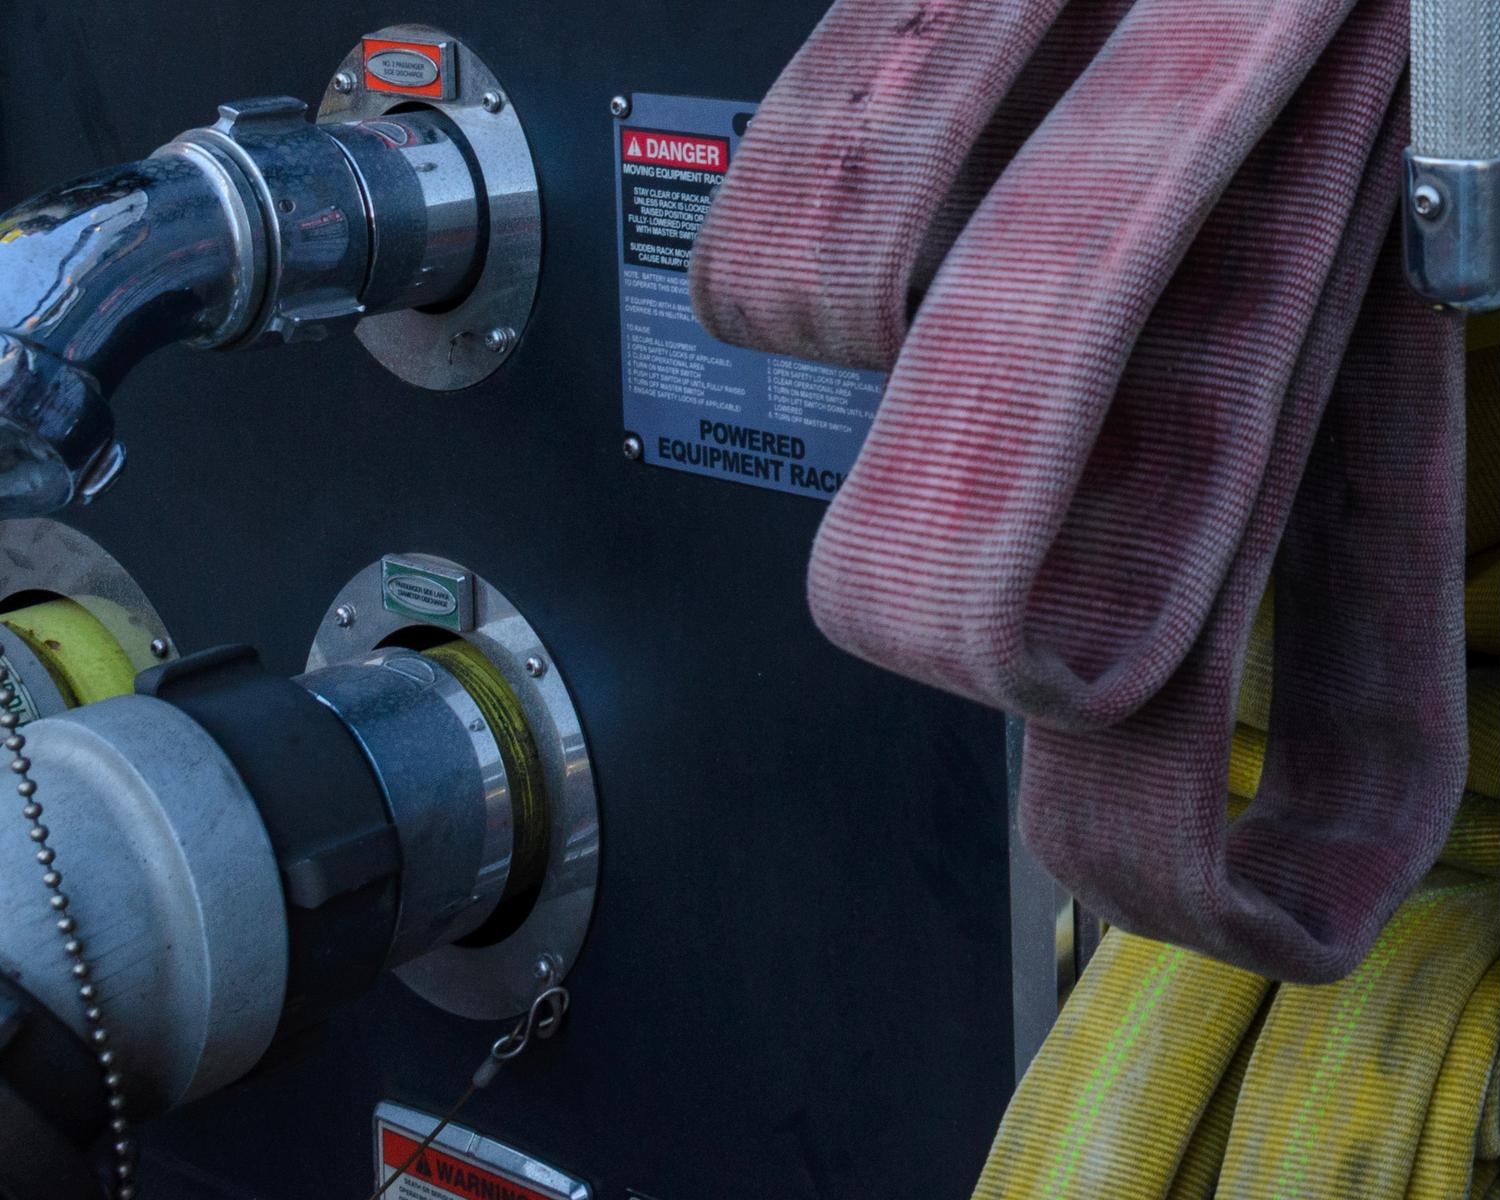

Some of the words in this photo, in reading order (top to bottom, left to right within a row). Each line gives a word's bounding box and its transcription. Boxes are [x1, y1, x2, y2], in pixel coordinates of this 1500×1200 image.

[646, 138, 719, 165] DANGER
[623, 164, 654, 177] MOVING
[656, 168, 702, 183] EQUIPMENT
[634, 187, 649, 195] STAY
[650, 189, 670, 198] CLEAR
[681, 193, 699, 202] RACK
[700, 196, 711, 204] AR
[634, 197, 658, 207] UNLESS
[659, 200, 676, 209] RACK
[678, 202, 684, 210] IS
[641, 207, 663, 217] RAISED
[665, 210, 693, 220] POSITION
[649, 218, 680, 229] LOWERED
[636, 225, 651, 233] WITH
[653, 227, 678, 238] MASTER
[630, 242, 655, 253] SUDDEN
[656, 247, 673, 255] RACK
[638, 253, 659, 263] CAUSE
[661, 257, 682, 267] INJURY
[699, 419, 806, 460] POWERED
[658, 437, 784, 483] EQUIPMENT
